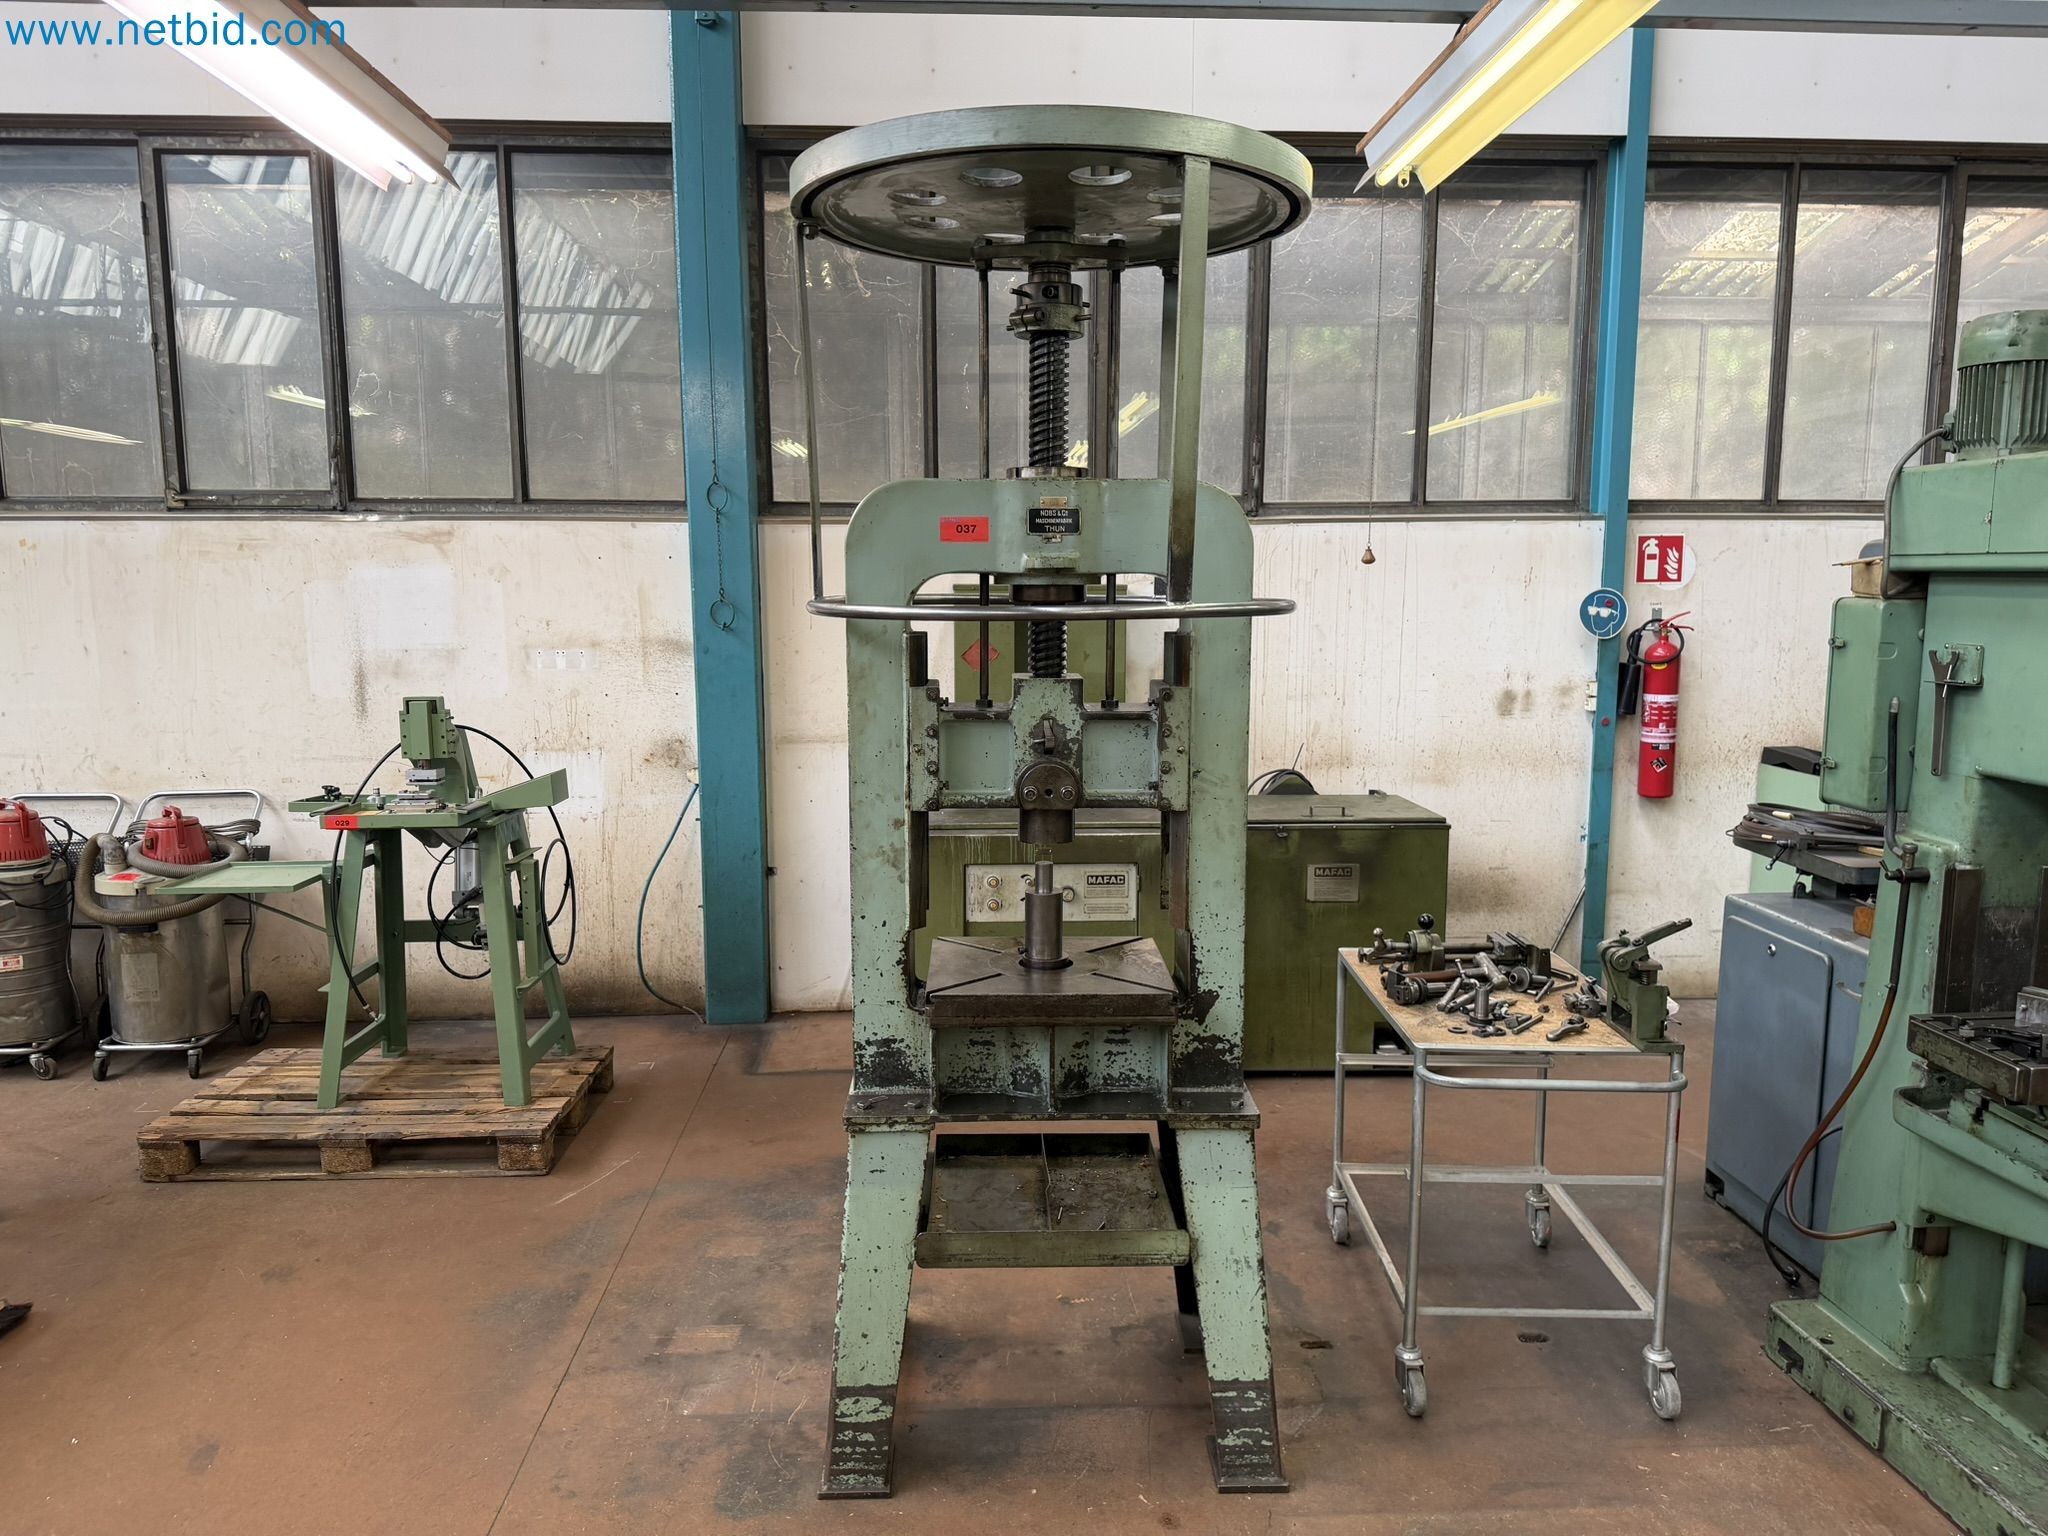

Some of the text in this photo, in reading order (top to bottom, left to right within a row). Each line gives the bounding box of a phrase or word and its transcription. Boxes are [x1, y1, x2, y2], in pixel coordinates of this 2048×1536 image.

[955, 524, 977, 534] 037
[1315, 868, 1351, 876] MAFAC
[1088, 876, 1124, 884] MAFAC
